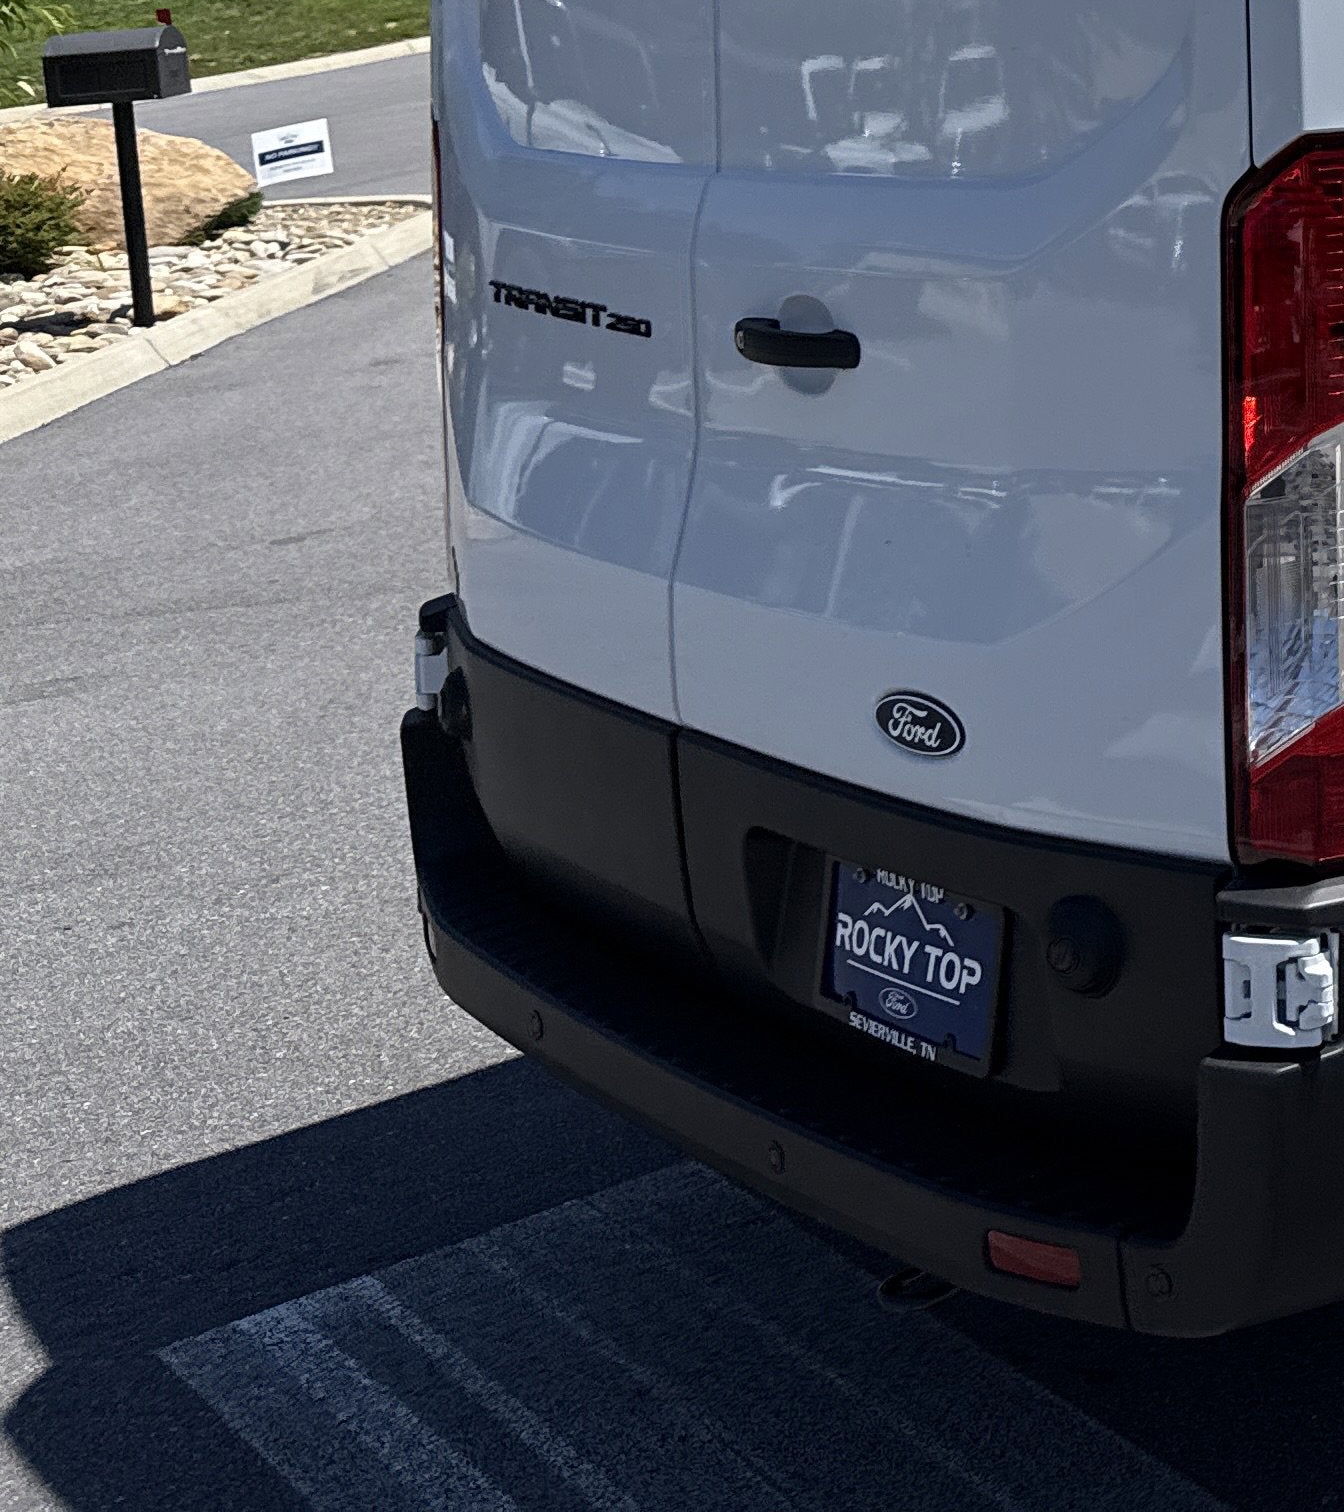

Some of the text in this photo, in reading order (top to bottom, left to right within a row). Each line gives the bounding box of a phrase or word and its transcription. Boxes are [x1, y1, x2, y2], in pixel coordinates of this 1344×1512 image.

[489, 280, 652, 339] TRANSIT 250
[888, 701, 942, 748] Ford
[835, 912, 982, 994] ROCKY TOP
[885, 990, 911, 1015] Ford
[849, 1010, 937, 1062] SEVIERVILLE, TN
